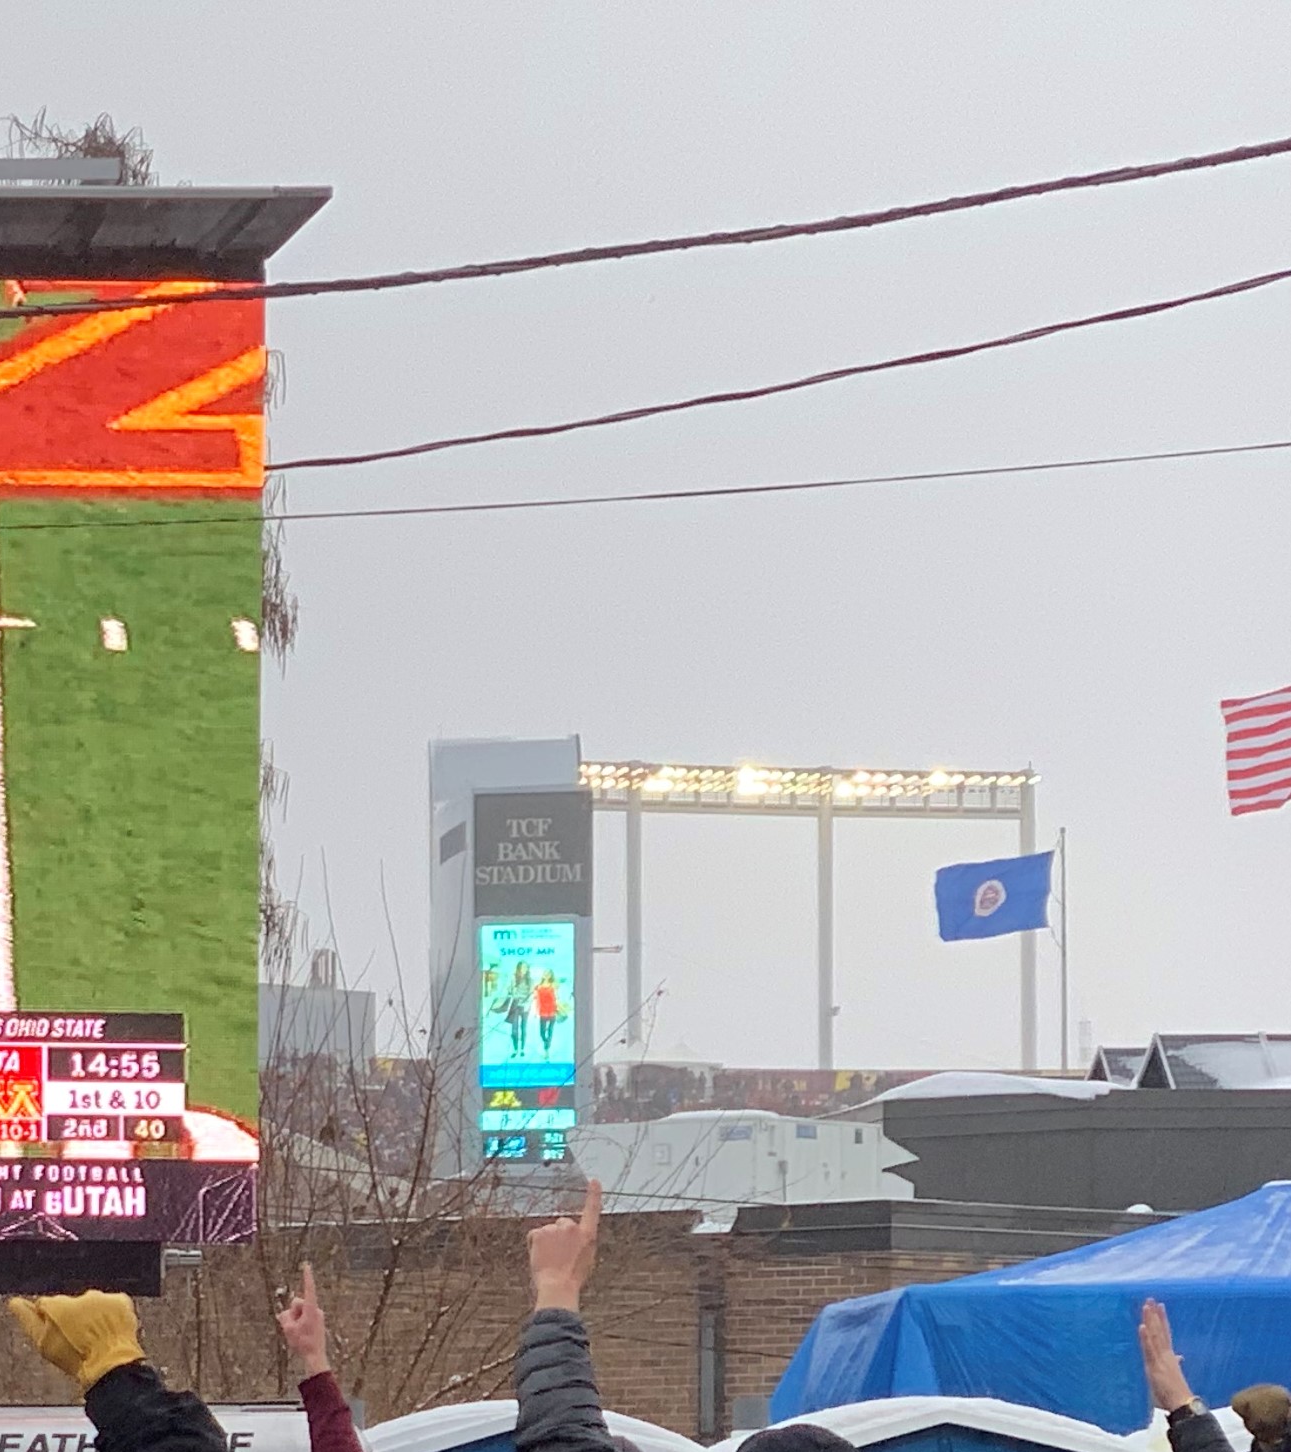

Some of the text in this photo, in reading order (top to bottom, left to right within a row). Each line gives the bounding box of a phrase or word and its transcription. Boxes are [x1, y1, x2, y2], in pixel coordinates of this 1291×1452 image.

[506, 818, 552, 838] TCF
[498, 841, 561, 861] BANK
[475, 863, 584, 885] STADIUM
[6, 1019, 50, 1037] OHIO
[52, 1019, 106, 1038] STATE
[70, 1052, 161, 1079] 14:55
[69, 1090, 161, 1109] 1st & 10
[0, 1123, 38, 1139] 10-1
[63, 1118, 108, 1138] 2nd
[135, 1119, 166, 1139] 40
[35, 1165, 145, 1183] FOOTBALL
[10, 1190, 37, 1210] AT
